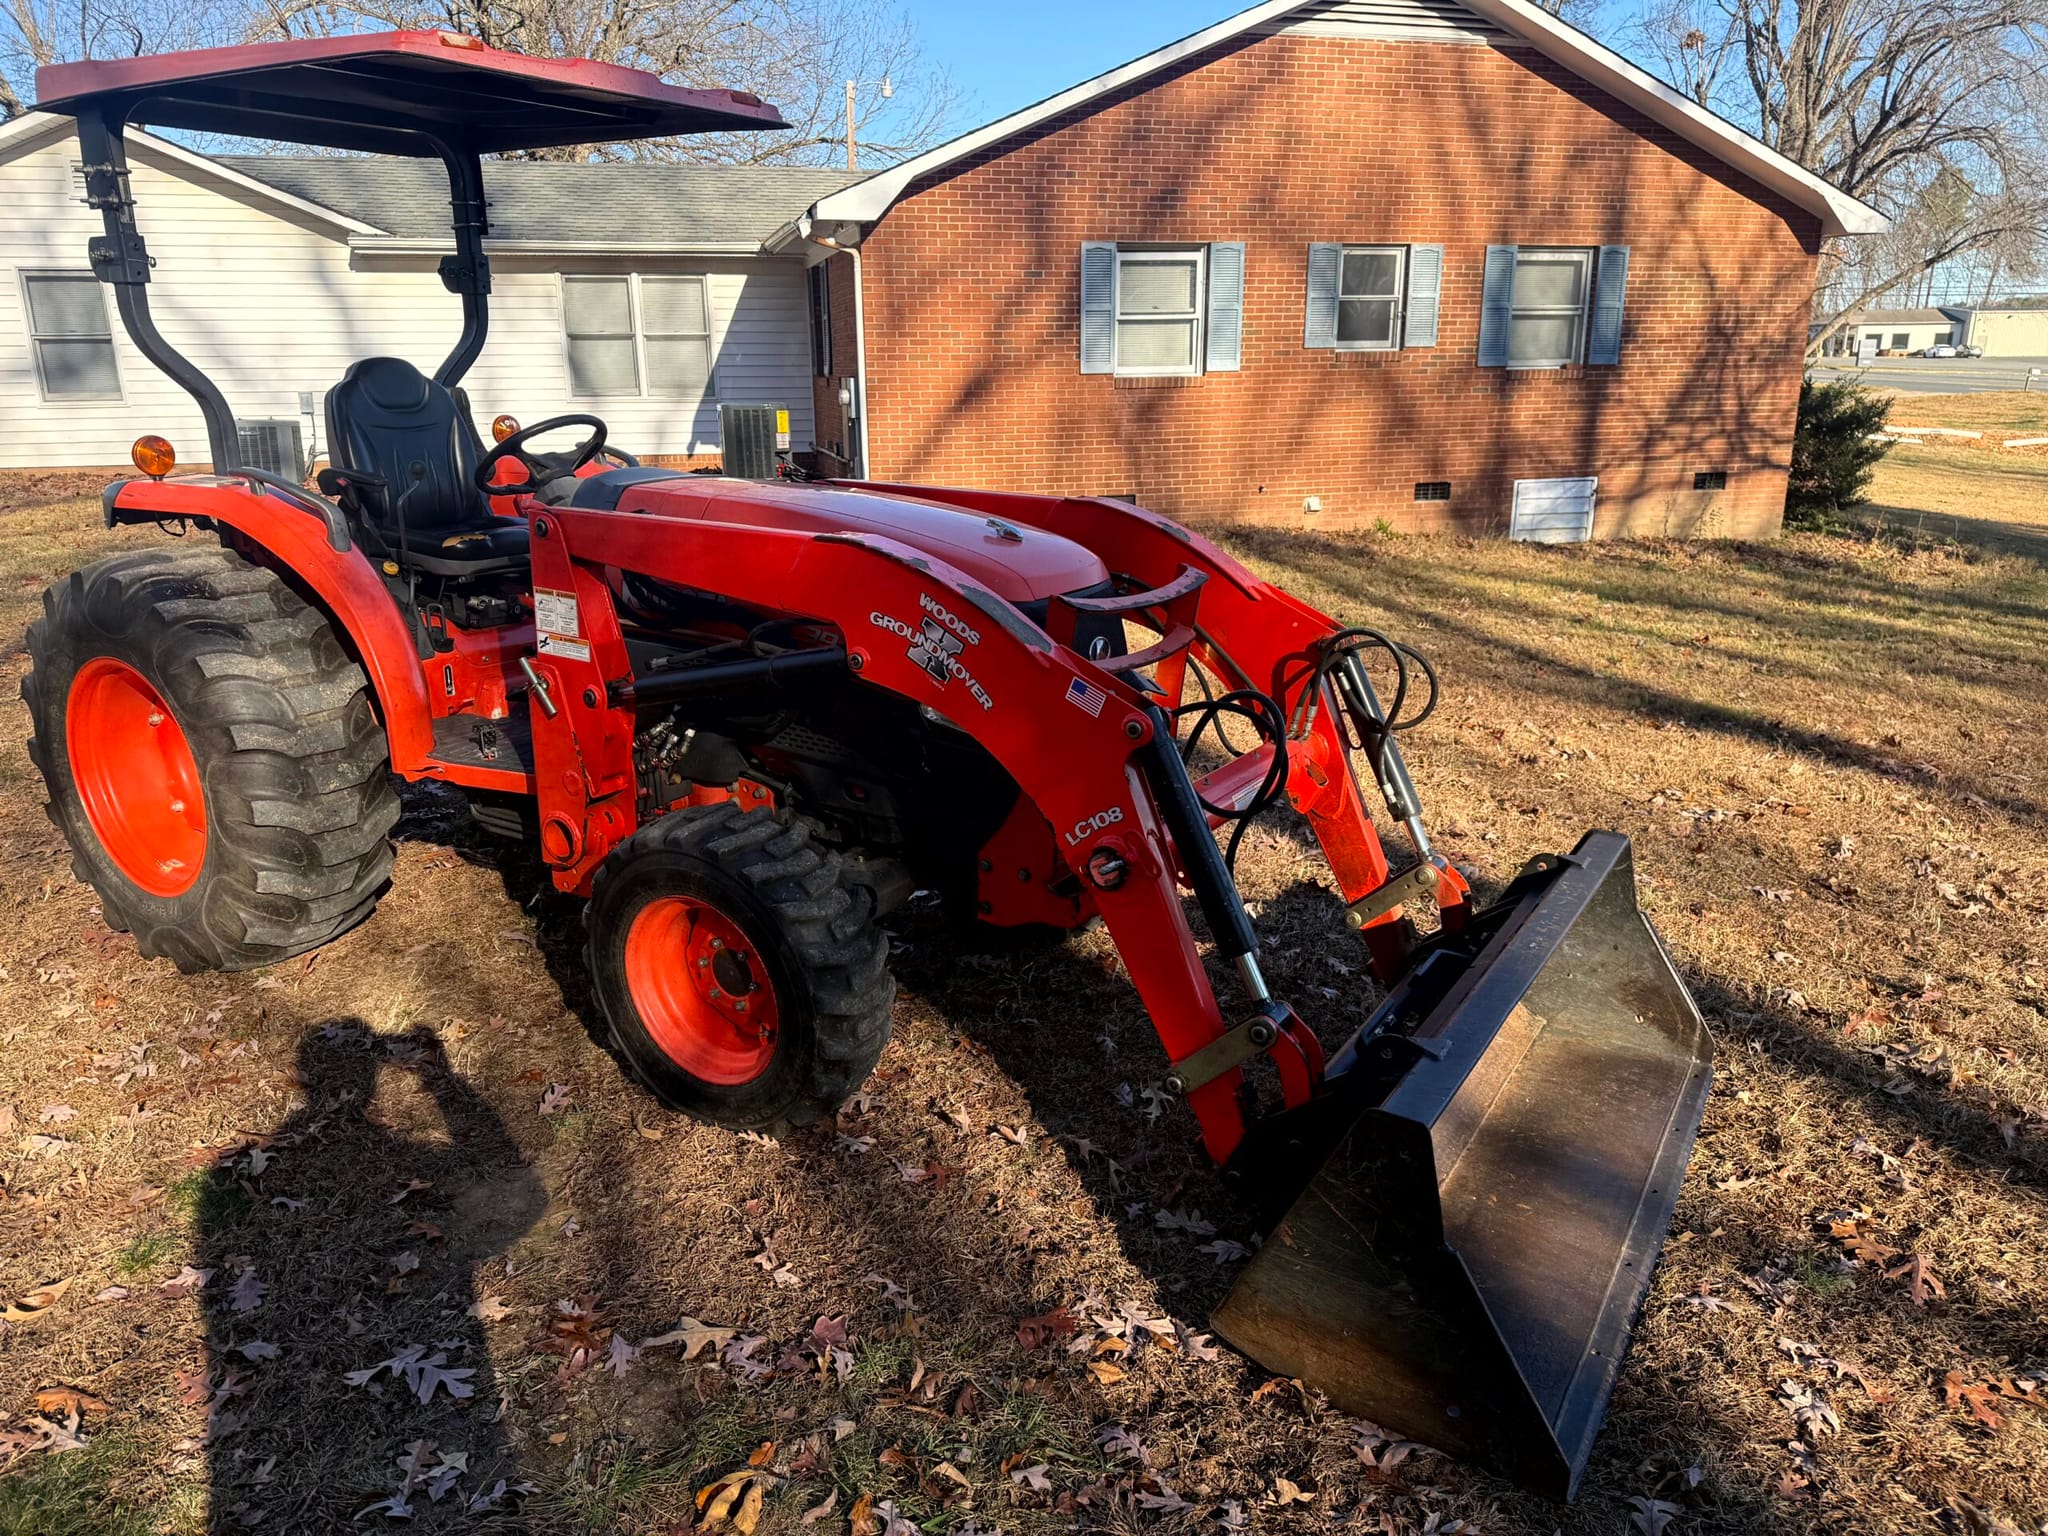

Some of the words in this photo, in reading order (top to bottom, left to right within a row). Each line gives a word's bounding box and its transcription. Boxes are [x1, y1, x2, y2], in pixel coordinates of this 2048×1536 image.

[919, 592, 981, 646] WOODS
[869, 611, 993, 711] GROUNDMOVER
[1065, 806, 1124, 847] LC108
